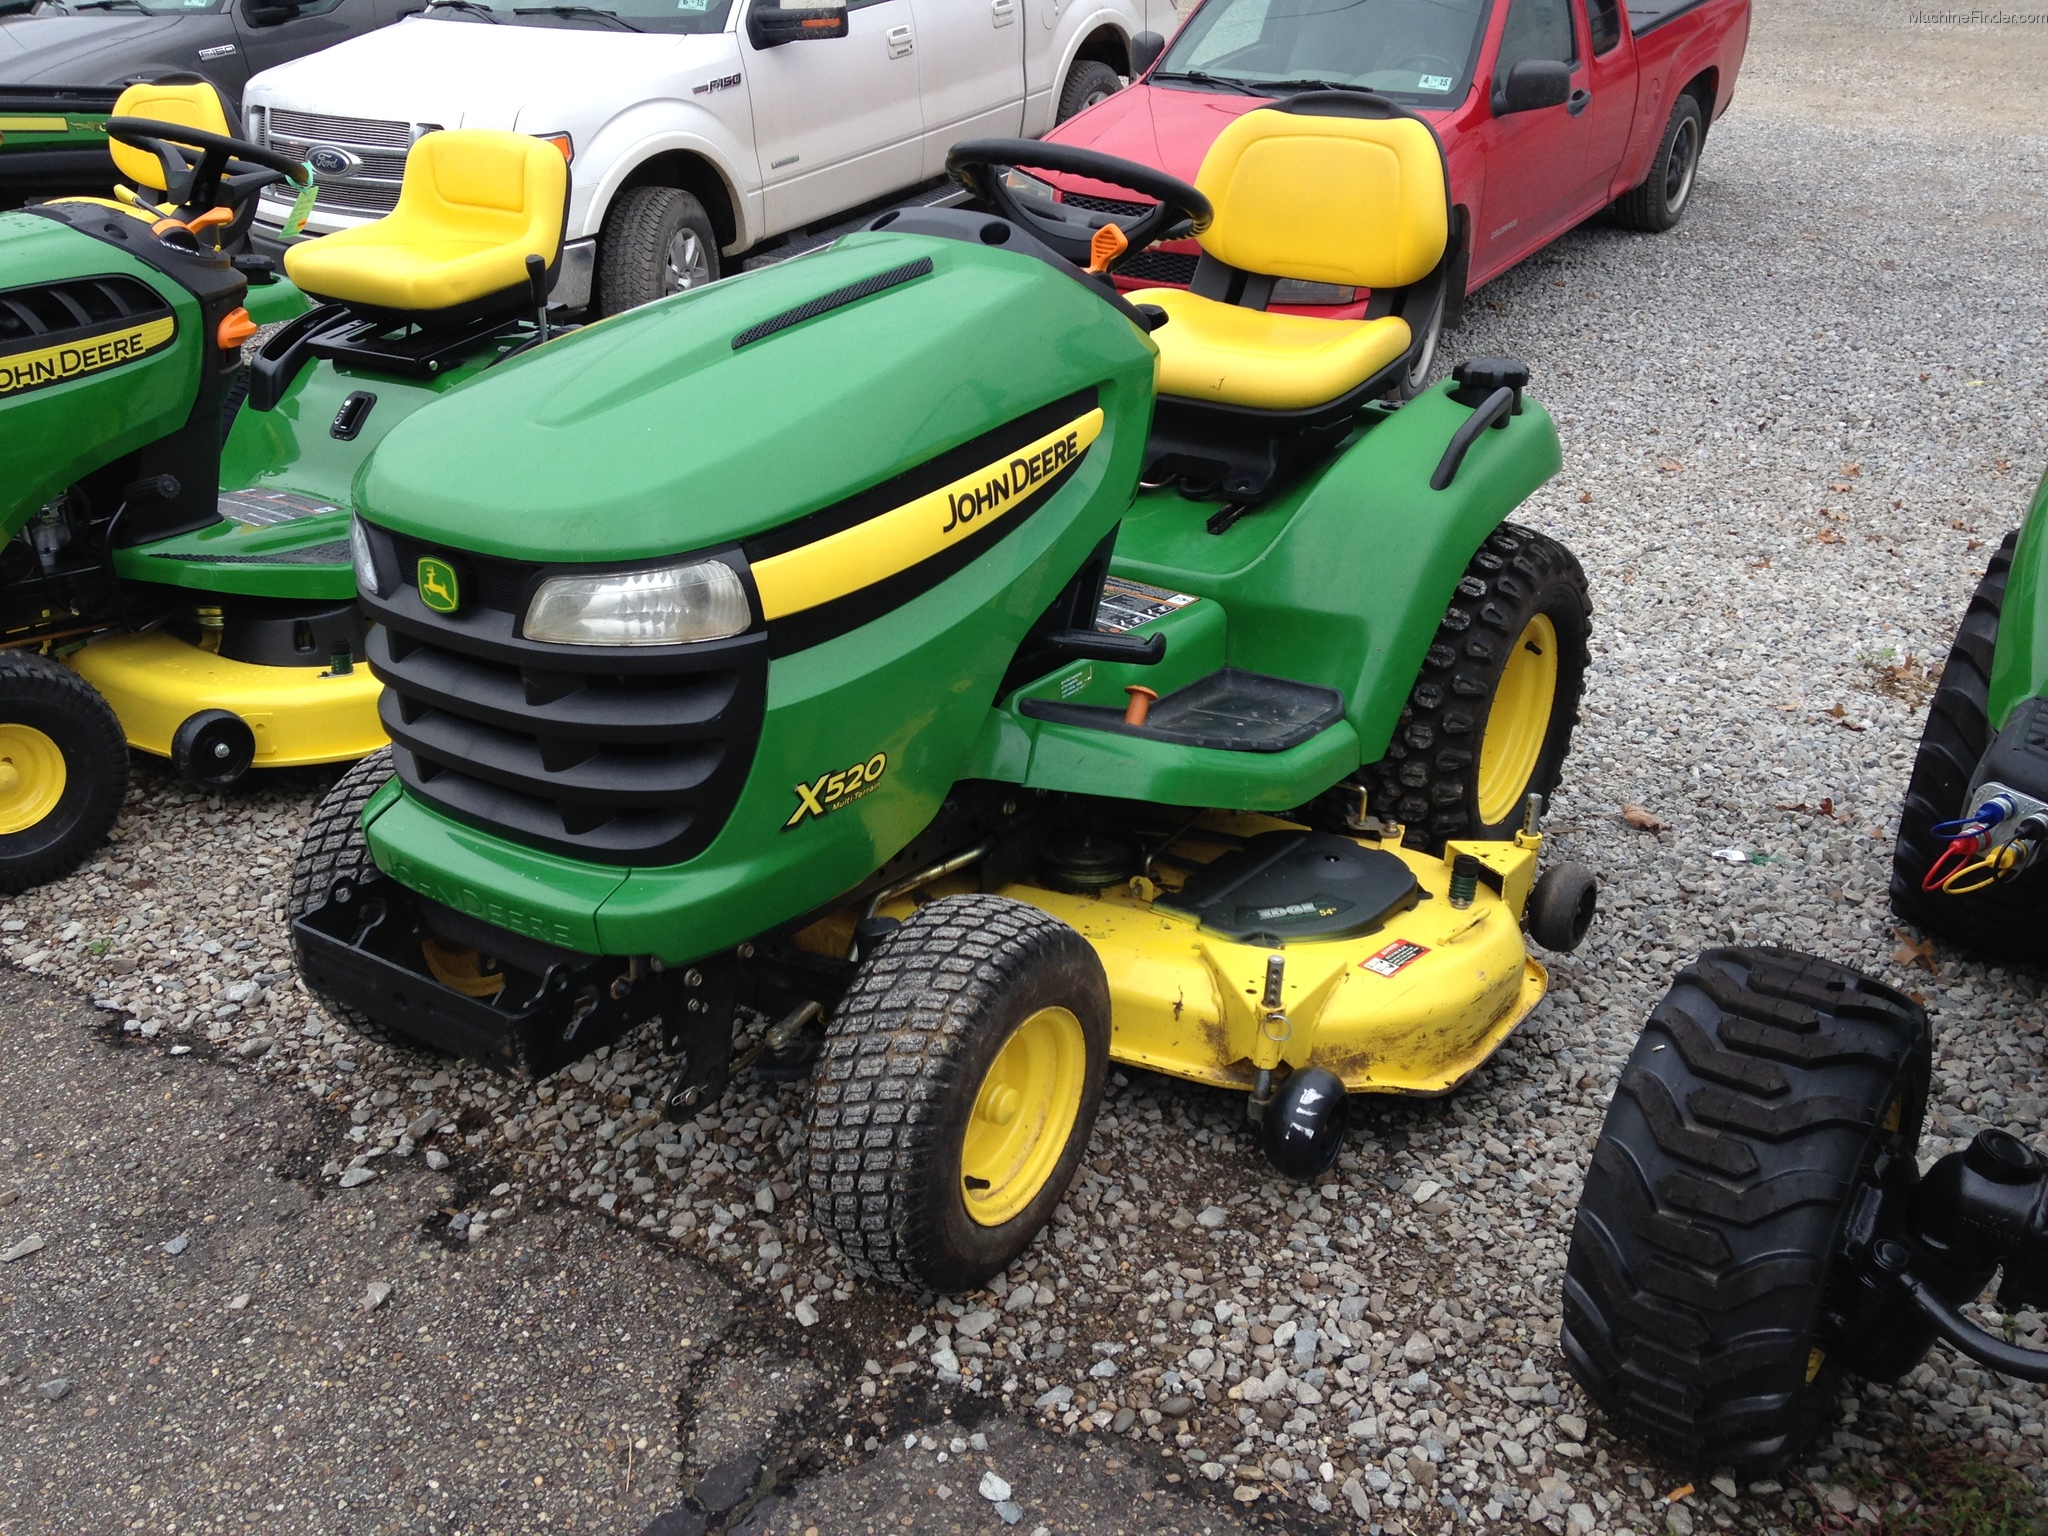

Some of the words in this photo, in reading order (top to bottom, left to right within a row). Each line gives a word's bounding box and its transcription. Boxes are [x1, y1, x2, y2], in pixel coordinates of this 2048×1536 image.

[1423, 76, 1430, 84] 4
[1440, 79, 1449, 87] 15
[316, 153, 338, 169] Ford
[0, 359, 55, 389] OHN
[60, 333, 144, 373] DEERE
[943, 473, 1010, 534] JOHN
[1009, 431, 1078, 495] DEERE
[784, 753, 887, 829] X520
[461, 888, 575, 948] DEERE
[1257, 902, 1317, 920] EDGE
